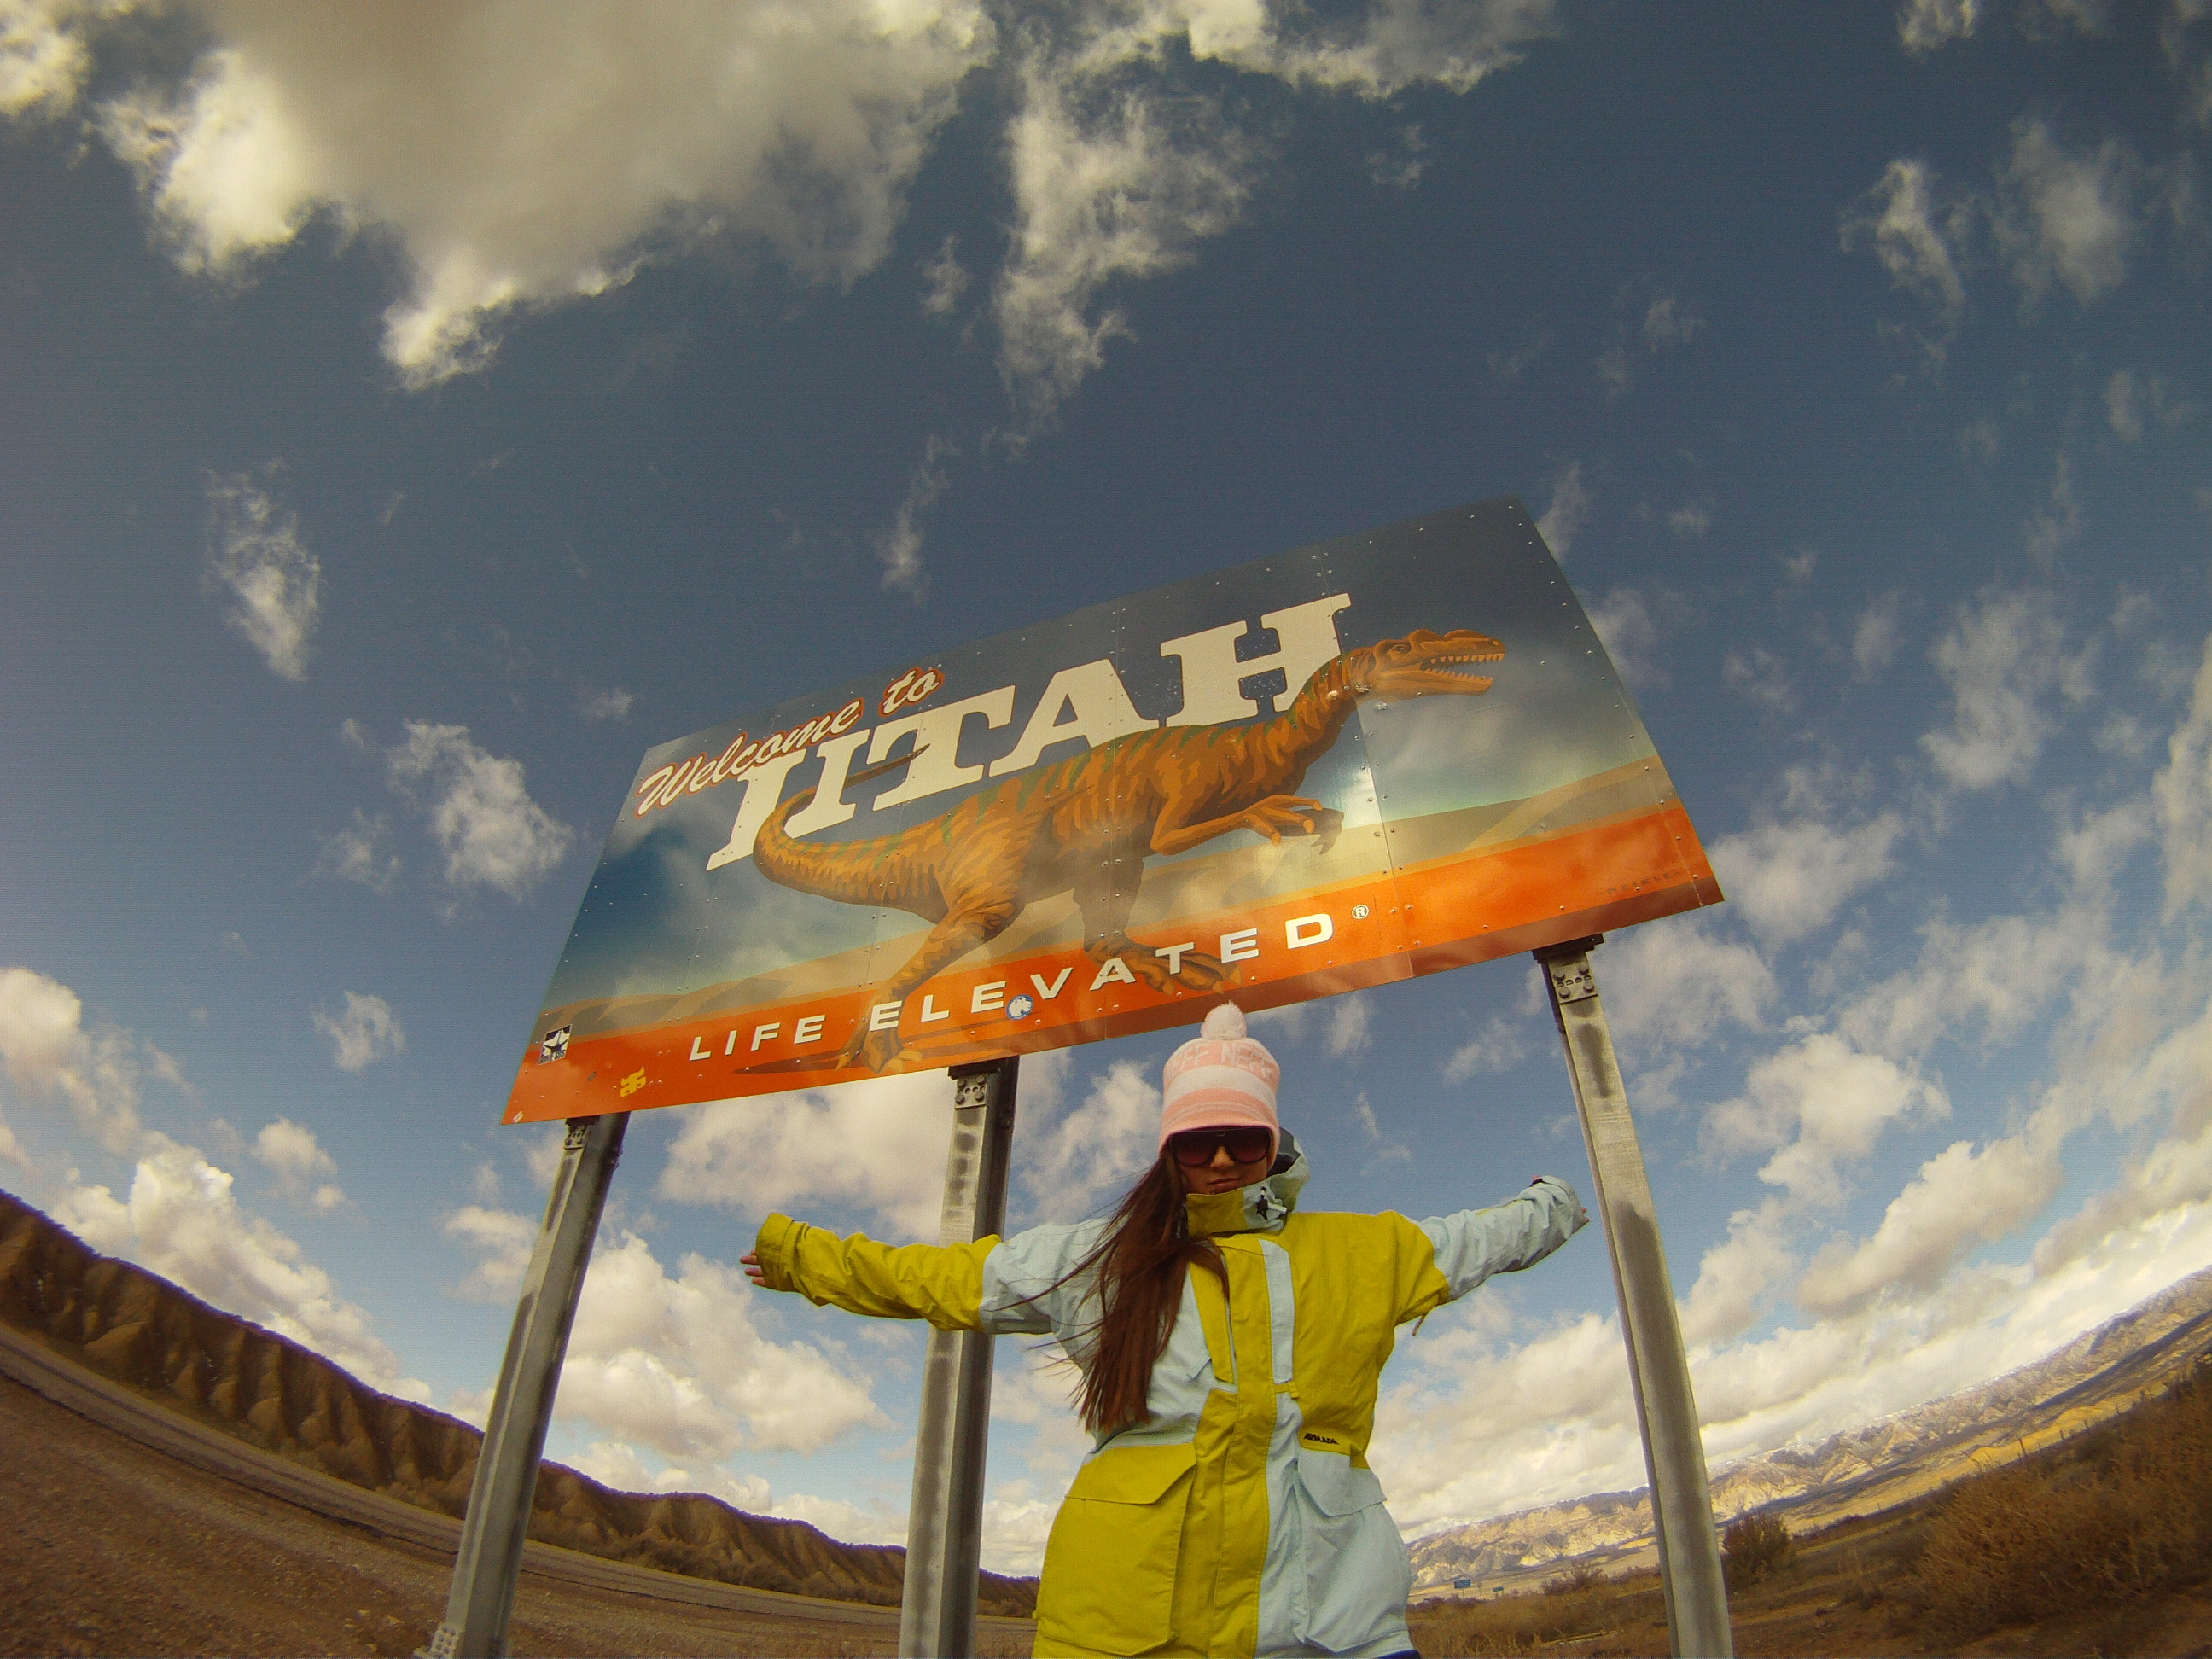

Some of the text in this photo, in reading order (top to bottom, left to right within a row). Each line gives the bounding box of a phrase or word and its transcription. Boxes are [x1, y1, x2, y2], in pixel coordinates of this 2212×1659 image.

[637, 667, 942, 817] Welcome to
[706, 593, 1352, 870] UTAH
[689, 1014, 826, 1062] LIFE
[869, 913, 1334, 1032] ELEVATED
